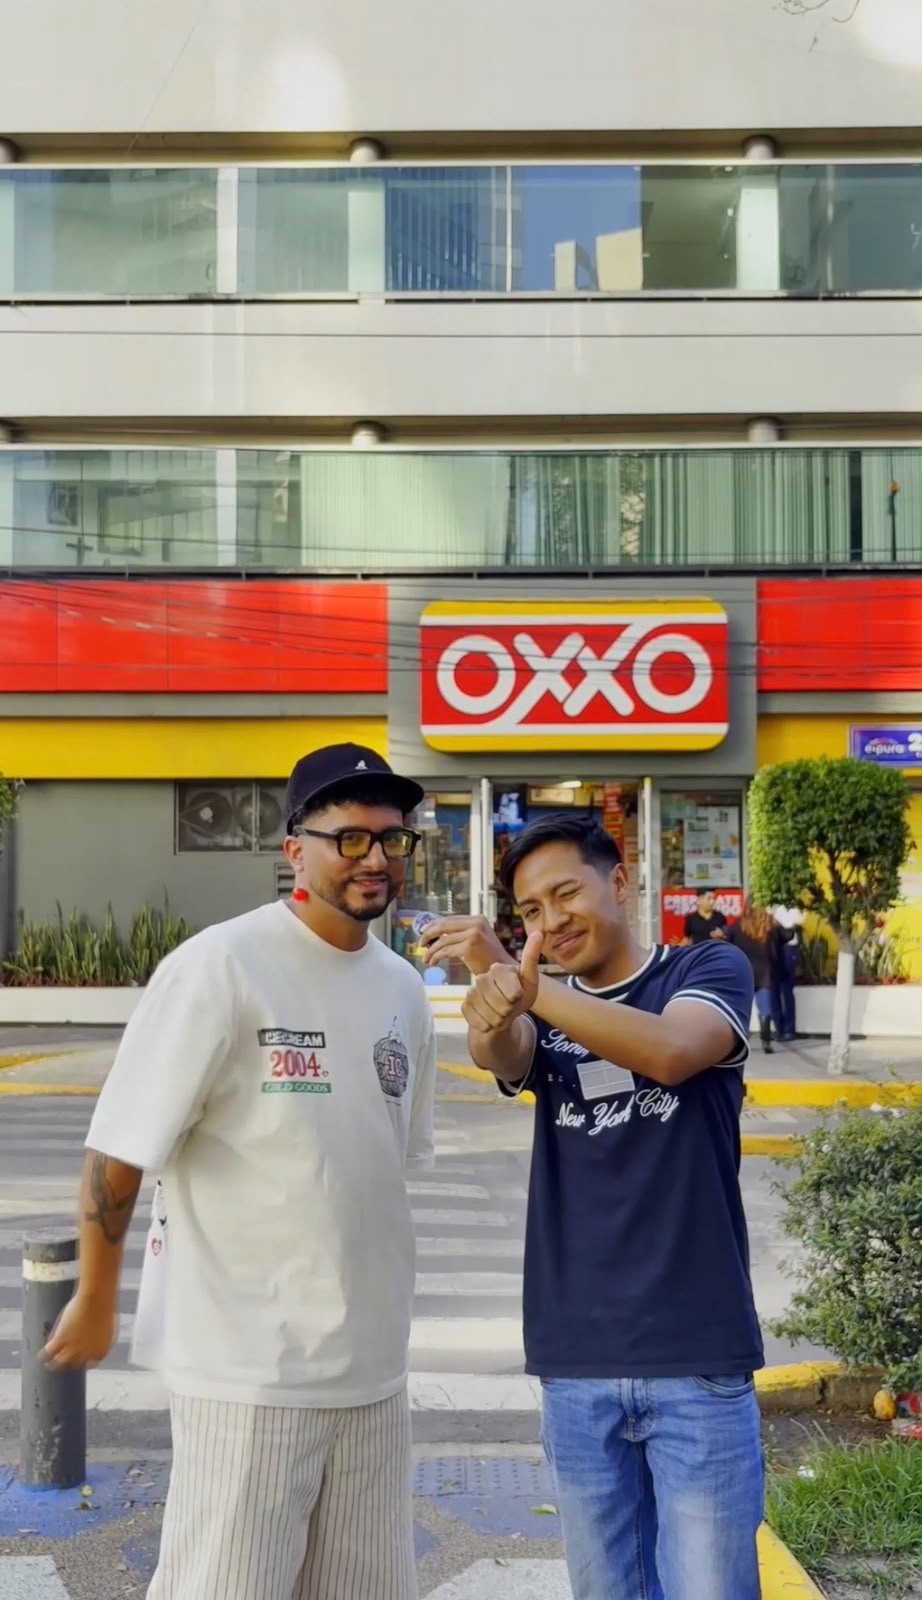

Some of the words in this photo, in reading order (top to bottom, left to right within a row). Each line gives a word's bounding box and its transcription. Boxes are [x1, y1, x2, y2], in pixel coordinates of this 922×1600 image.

[437, 625, 712, 726] OXXO
[270, 1049, 321, 1077] 2004
[555, 1102, 586, 1127] New
[588, 1094, 635, 1136] York
[635, 1087, 679, 1122] City
